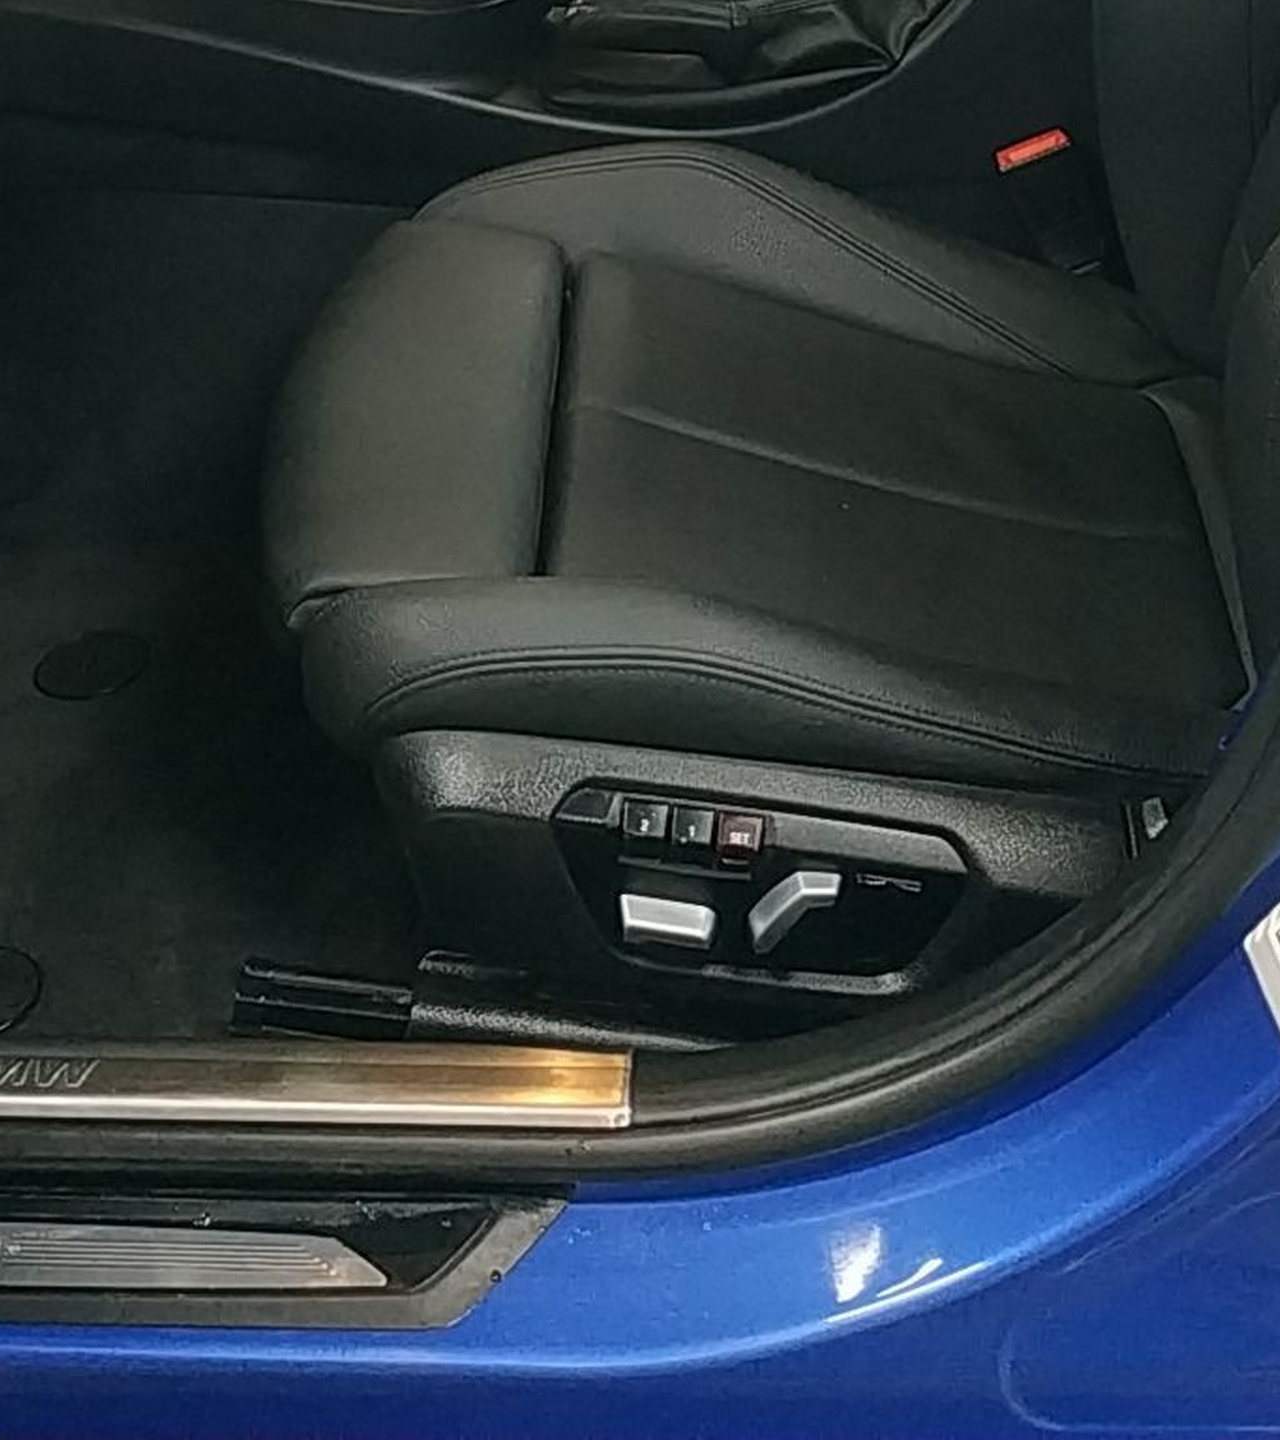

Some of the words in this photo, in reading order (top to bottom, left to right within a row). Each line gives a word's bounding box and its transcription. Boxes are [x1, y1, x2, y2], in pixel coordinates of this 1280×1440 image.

[639, 818, 650, 832] 2
[688, 824, 696, 838] 1
[729, 831, 750, 846] SET
